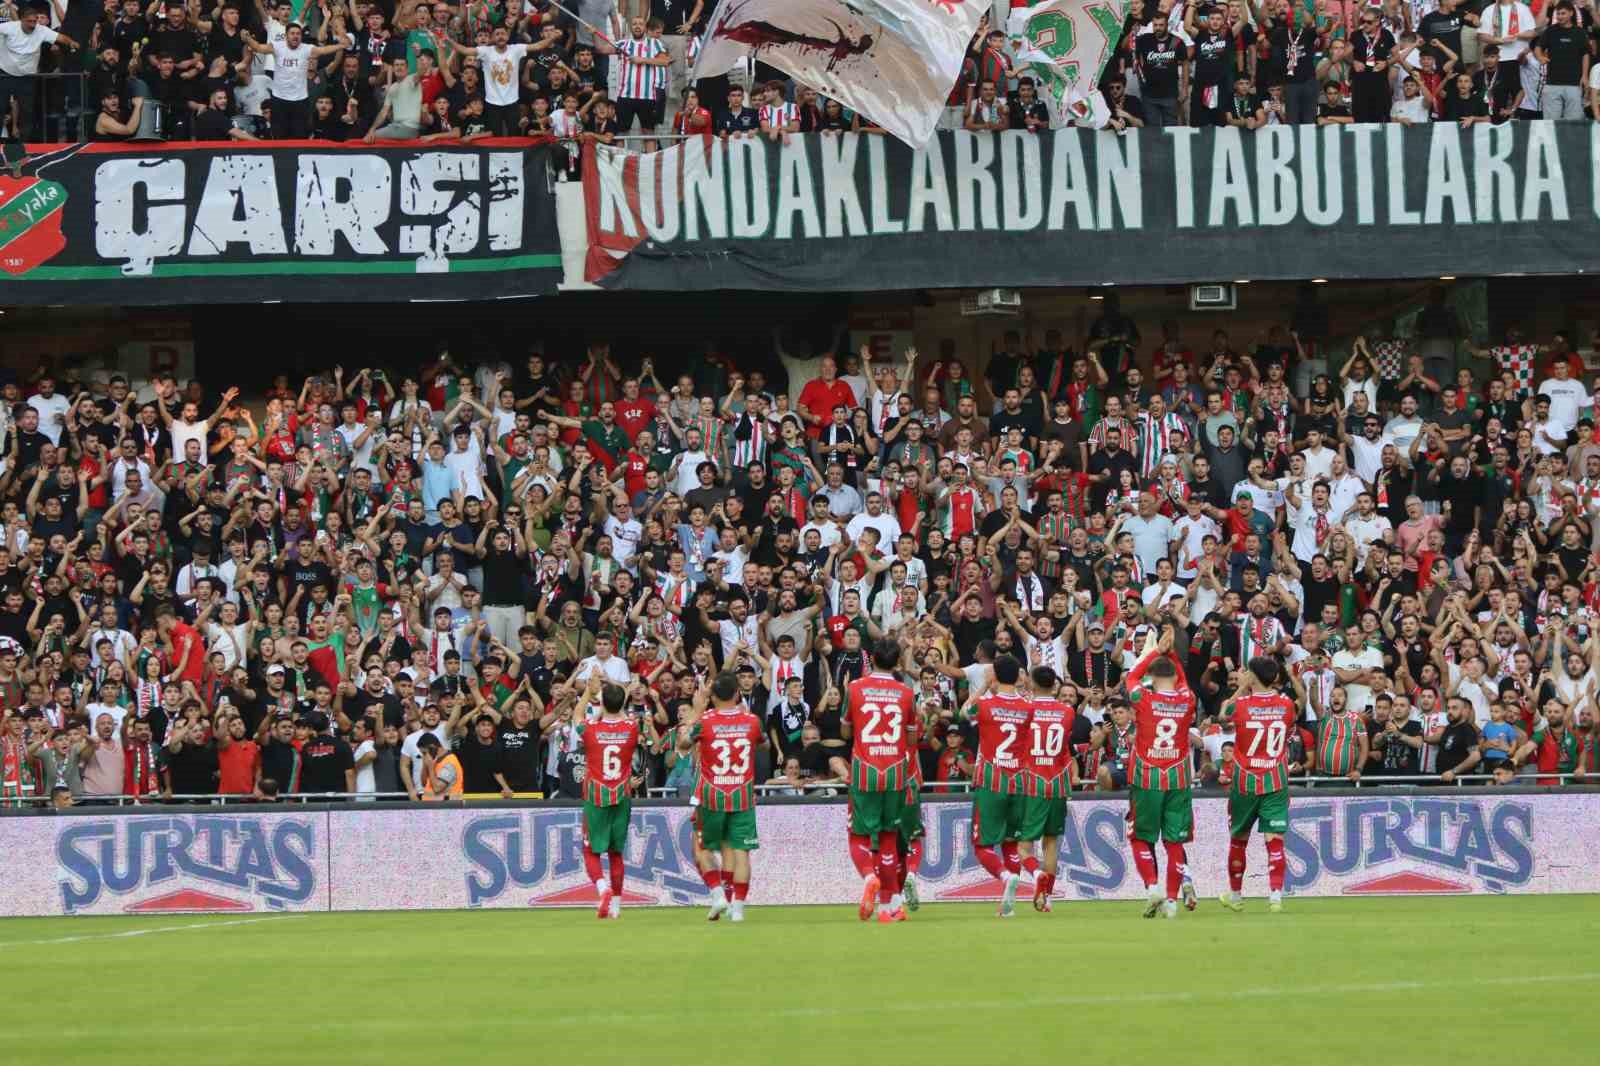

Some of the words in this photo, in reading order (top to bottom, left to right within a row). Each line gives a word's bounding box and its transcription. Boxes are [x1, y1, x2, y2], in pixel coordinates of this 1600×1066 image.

[596, 127, 1142, 243] KUNDAKLARDAN
[1163, 119, 1570, 226] TABUTLARA
[633, 461, 644, 471] 12
[833, 622, 844, 632] 12
[860, 703, 902, 743] 23
[1029, 722, 1065, 757] 10
[1153, 718, 1179, 750] 8
[1245, 720, 1287, 758] 70
[566, 752, 587, 765] POL
[710, 738, 752, 775] 33
[996, 723, 1017, 760] 2
[602, 744, 622, 777] 6
